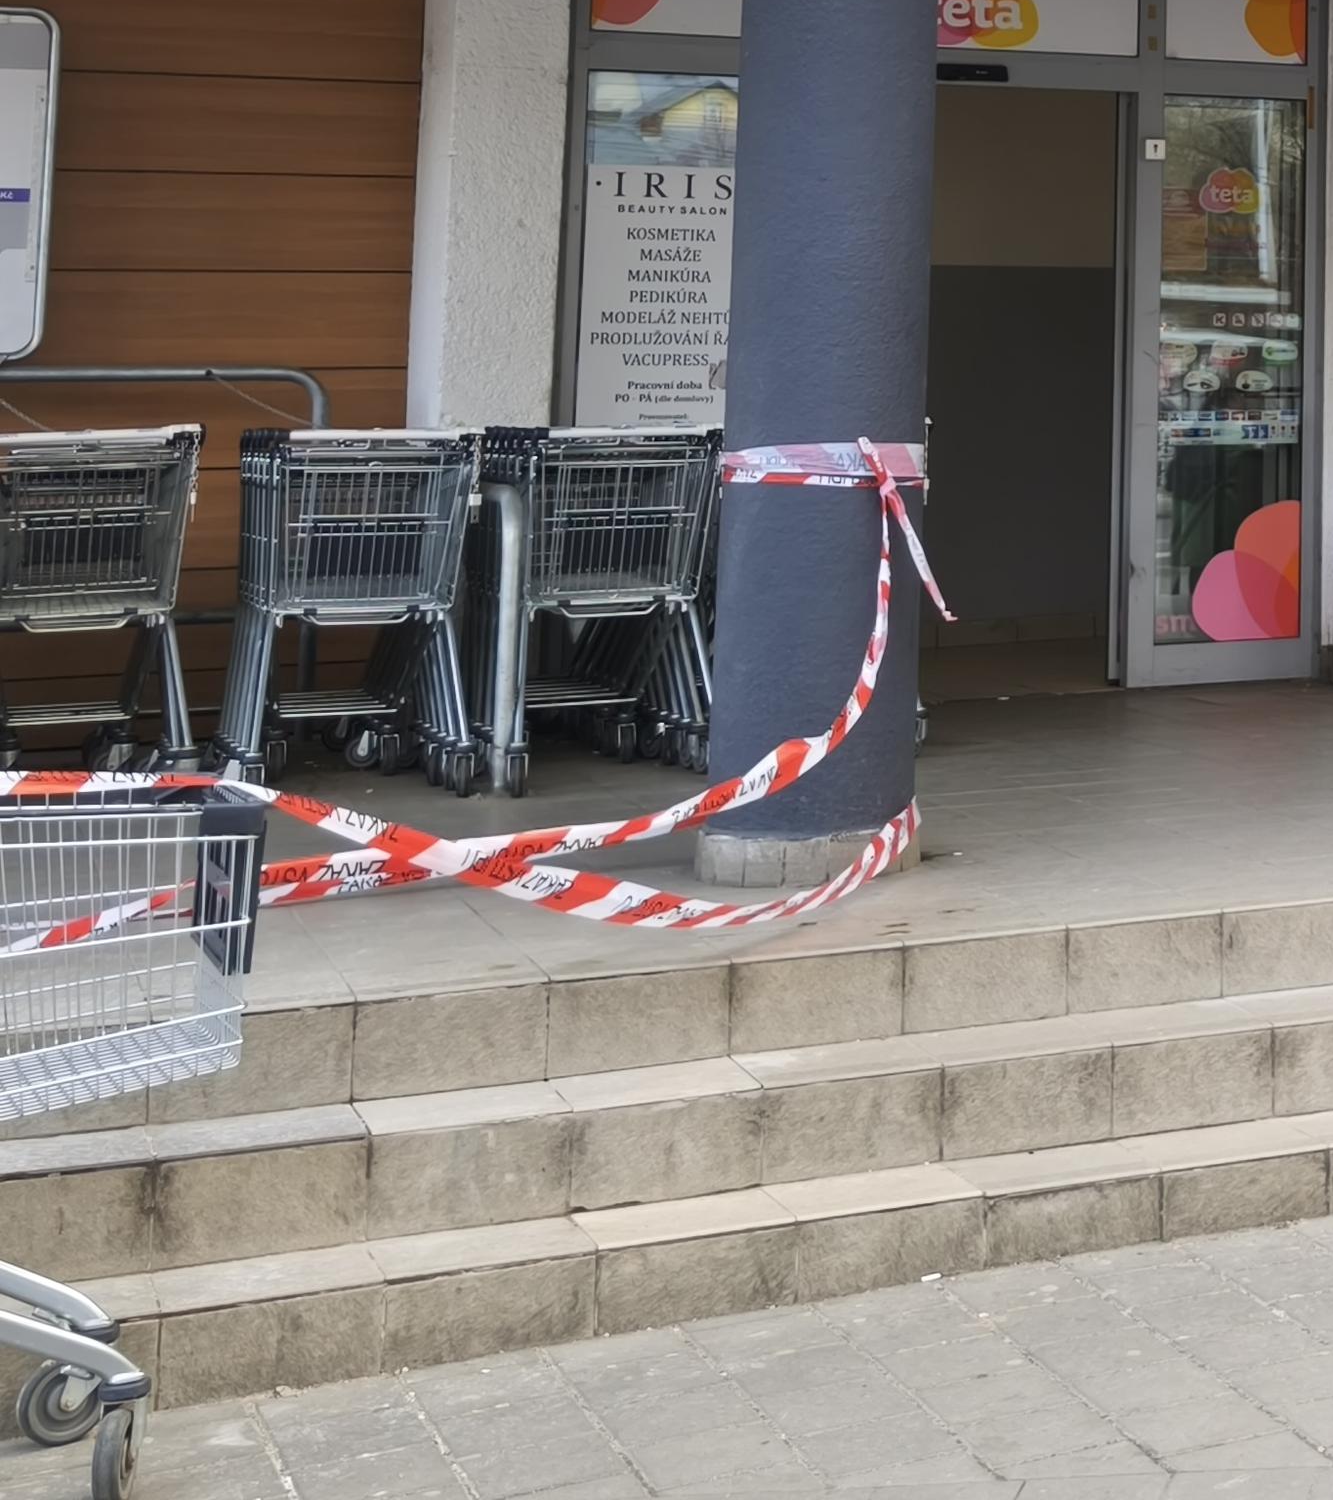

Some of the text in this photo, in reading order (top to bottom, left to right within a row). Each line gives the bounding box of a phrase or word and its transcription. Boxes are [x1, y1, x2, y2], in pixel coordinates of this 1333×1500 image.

[613, 171, 733, 201] IRIS
[1209, 185, 1253, 203] teta
[617, 204, 727, 216] BEAUTY SALON
[626, 227, 716, 242] KOSMETIKA
[639, 248, 702, 263] MASÁŽE
[627, 267, 712, 284] MANIKÚRA
[629, 287, 708, 304] PEDIKÚRA
[600, 308, 677, 325] MODELÁŽ
[590, 329, 709, 346] PRODLUŽOVÁNÍ
[622, 353, 710, 367] VACUPRESS
[627, 380, 702, 390] Pracovní doba
